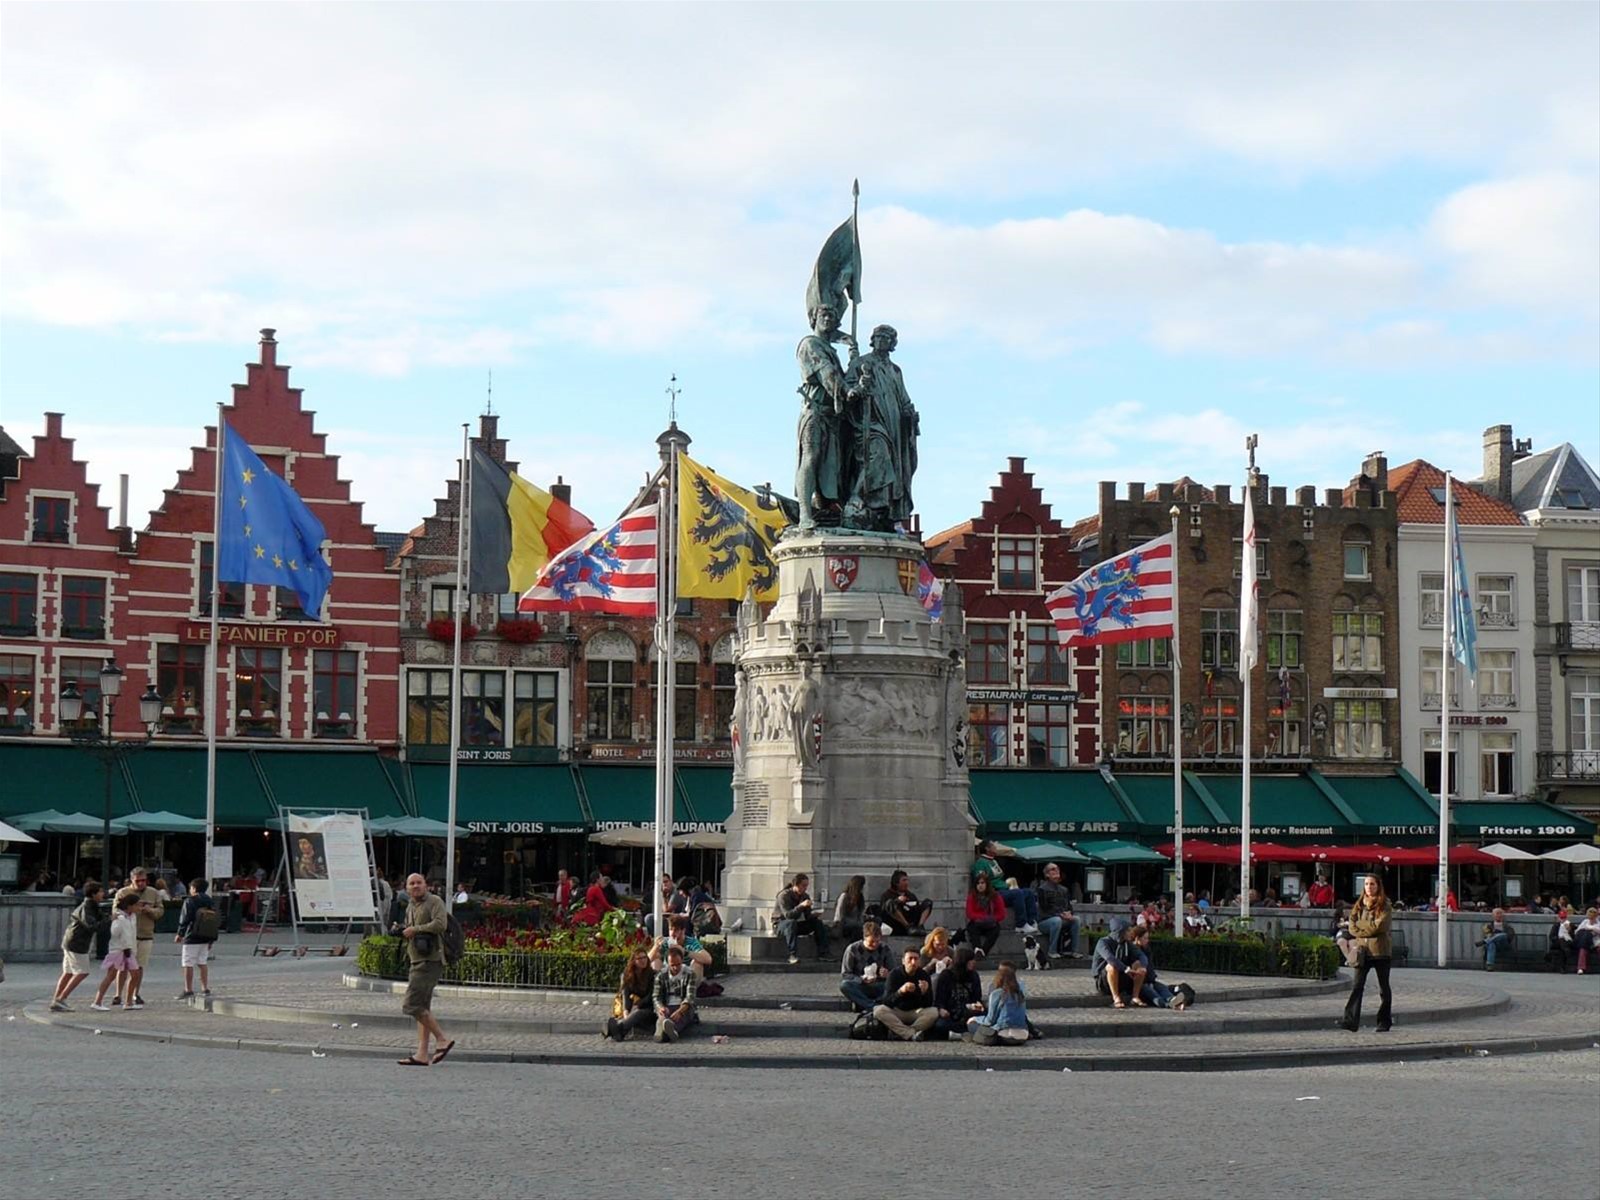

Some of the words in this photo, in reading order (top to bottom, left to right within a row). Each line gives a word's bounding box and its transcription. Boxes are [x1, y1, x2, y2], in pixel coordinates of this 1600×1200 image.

[187, 627, 212, 640] LE
[217, 626, 287, 642] PANIER
[965, 691, 1028, 700] RESTAURANT
[1437, 715, 1483, 725] FITERIE
[457, 750, 480, 760] SINT
[483, 751, 512, 760] JORIS
[595, 748, 624, 757] HOTEL
[641, 748, 698, 758] RERANT
[467, 821, 545, 834] SINT-JORIS
[550, 826, 585, 834] Brasserie
[641, 821, 725, 833] REAURANT
[1008, 822, 1045, 832] CAFE
[1049, 822, 1076, 832] DES
[1081, 822, 1119, 832] ARTS
[1166, 826, 1209, 834] Brsserie
[1216, 826, 1228, 834] La
[1229, 827, 1261, 835] Civre
[1262, 827, 1281, 835] d'Or
[1288, 827, 1334, 836] Restaurant
[1379, 825, 1408, 835] PETIT
[1409, 826, 1436, 835] CAFE
[1479, 826, 1533, 835] Friterie
[1537, 826, 1576, 835] 1900
